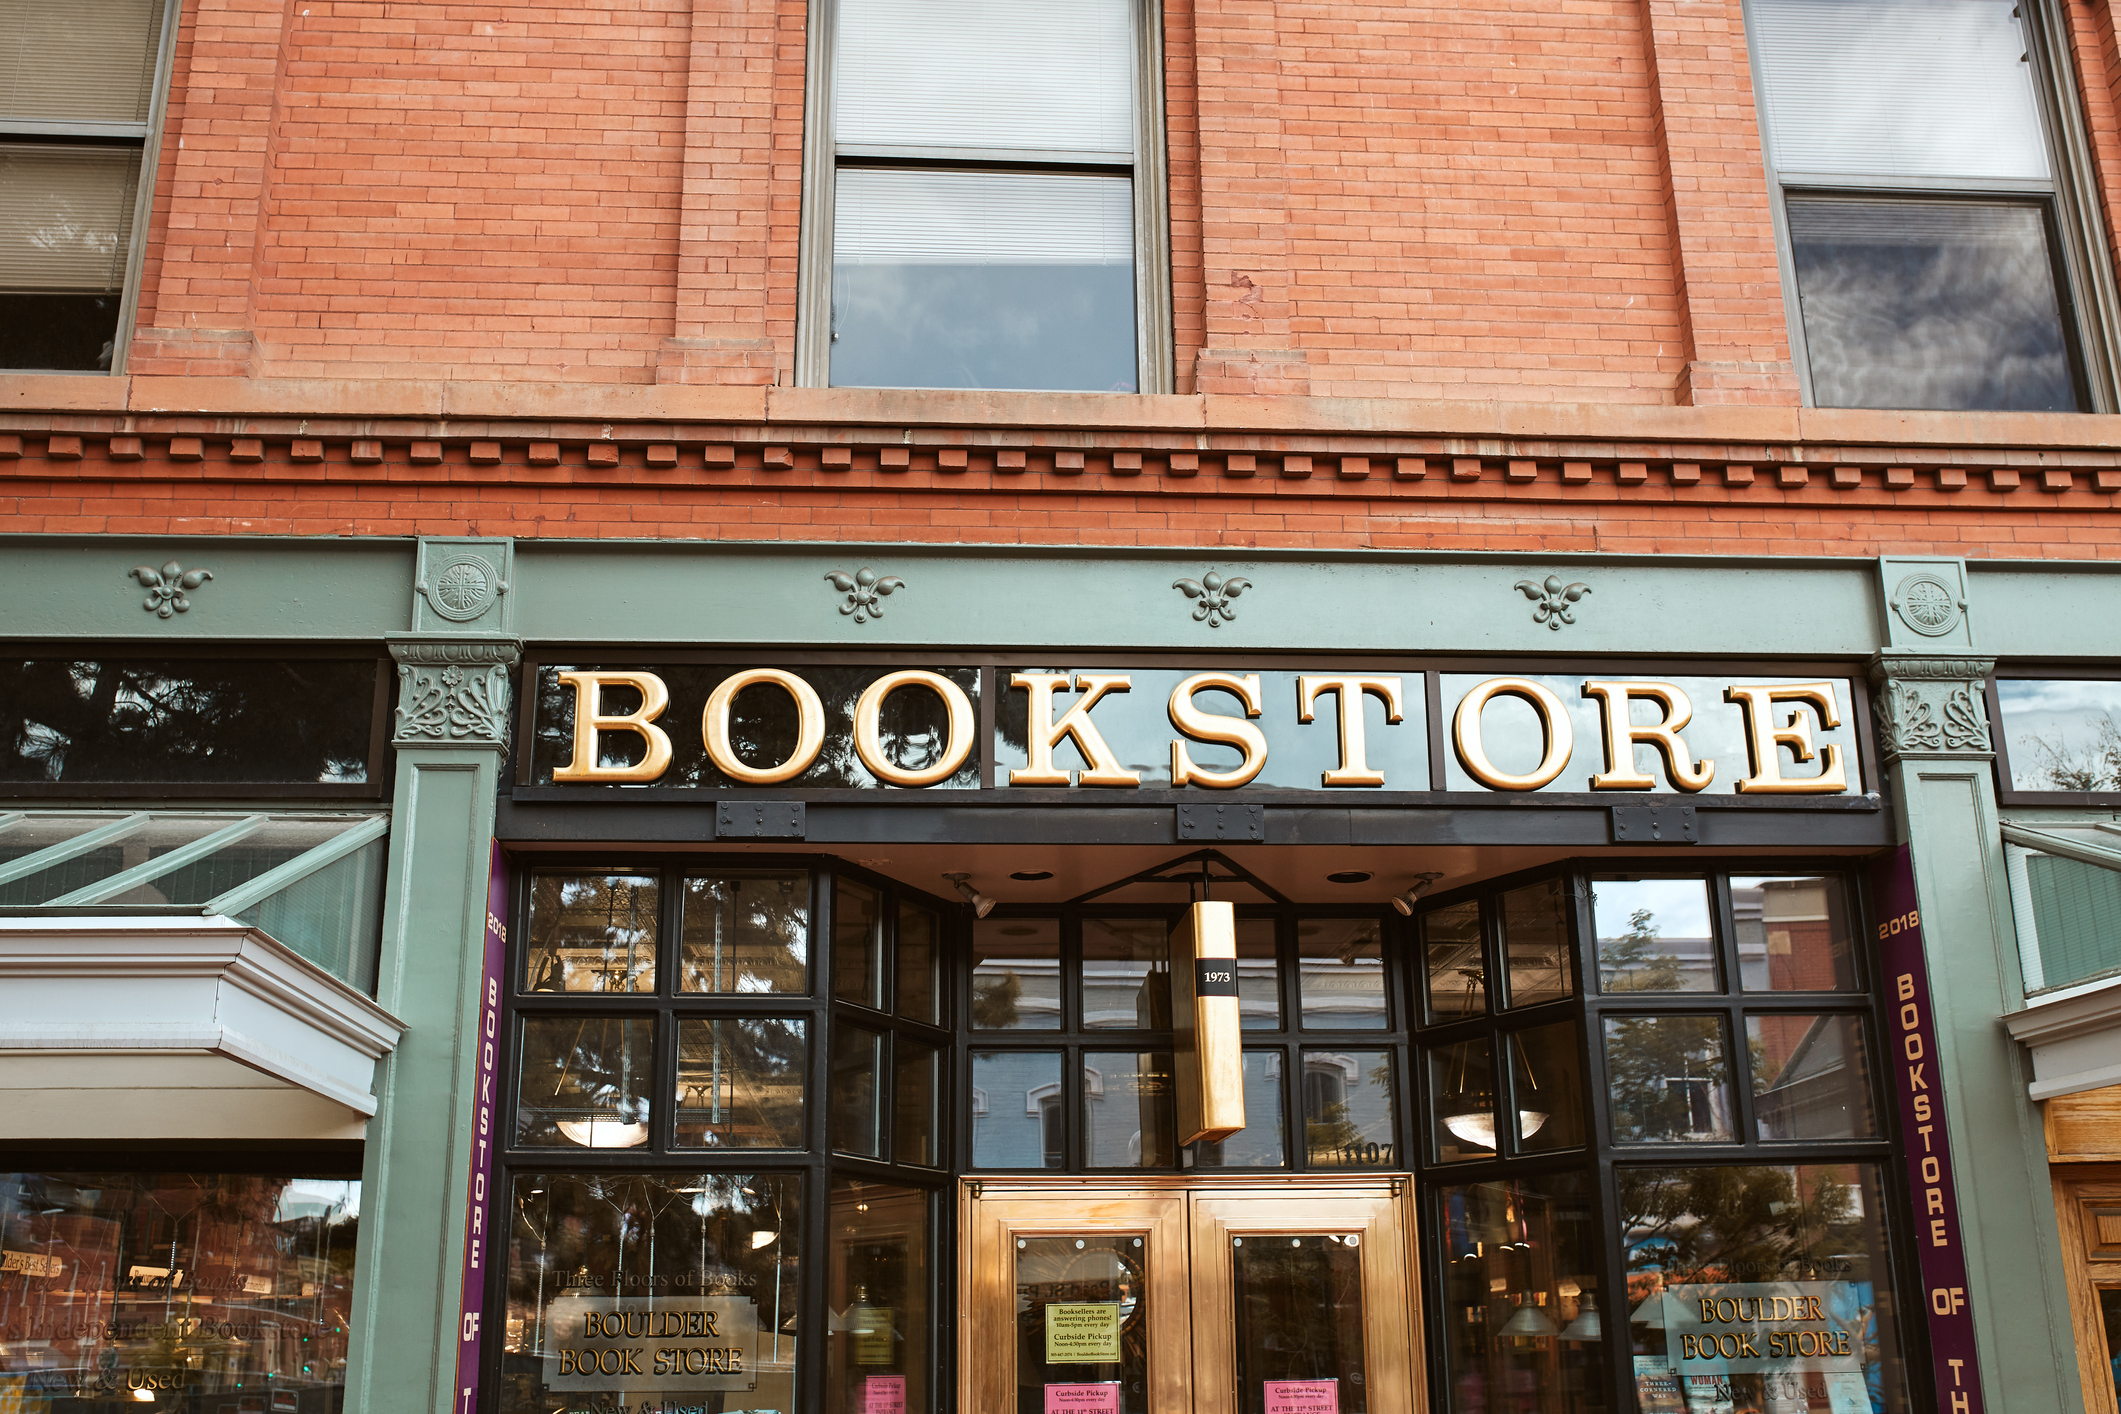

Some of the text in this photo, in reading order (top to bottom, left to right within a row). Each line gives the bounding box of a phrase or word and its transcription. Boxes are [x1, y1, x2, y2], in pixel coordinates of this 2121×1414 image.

[552, 667, 1847, 794] BOOKSTORE
[488, 911, 507, 944] 2018
[1878, 910, 1920, 940] 2018
[1204, 971, 1231, 983] 1973
[471, 977, 497, 1268] BOOKSTORE
[1344, 1142, 1393, 1164] 1107
[1897, 973, 1948, 1247] BOOKSTORE
[1932, 1287, 1965, 1315] OF
[552, 1269, 757, 1287] Three Floors of Books
[1800, 1256, 1852, 1273] Books
[1698, 1296, 1825, 1323] BOULDER
[463, 1312, 480, 1341] OF
[584, 1311, 720, 1338] BOULDER
[1087, 1333, 1112, 1341] Pickup
[1680, 1331, 1852, 1360] BOOK STORE
[558, 1347, 743, 1375] BOOK STORE
[31, 1367, 186, 1391] New & Used
[1690, 1375, 1723, 1385] WOMAN
[1783, 1381, 1828, 1399] Used
[589, 1400, 634, 1414] New
